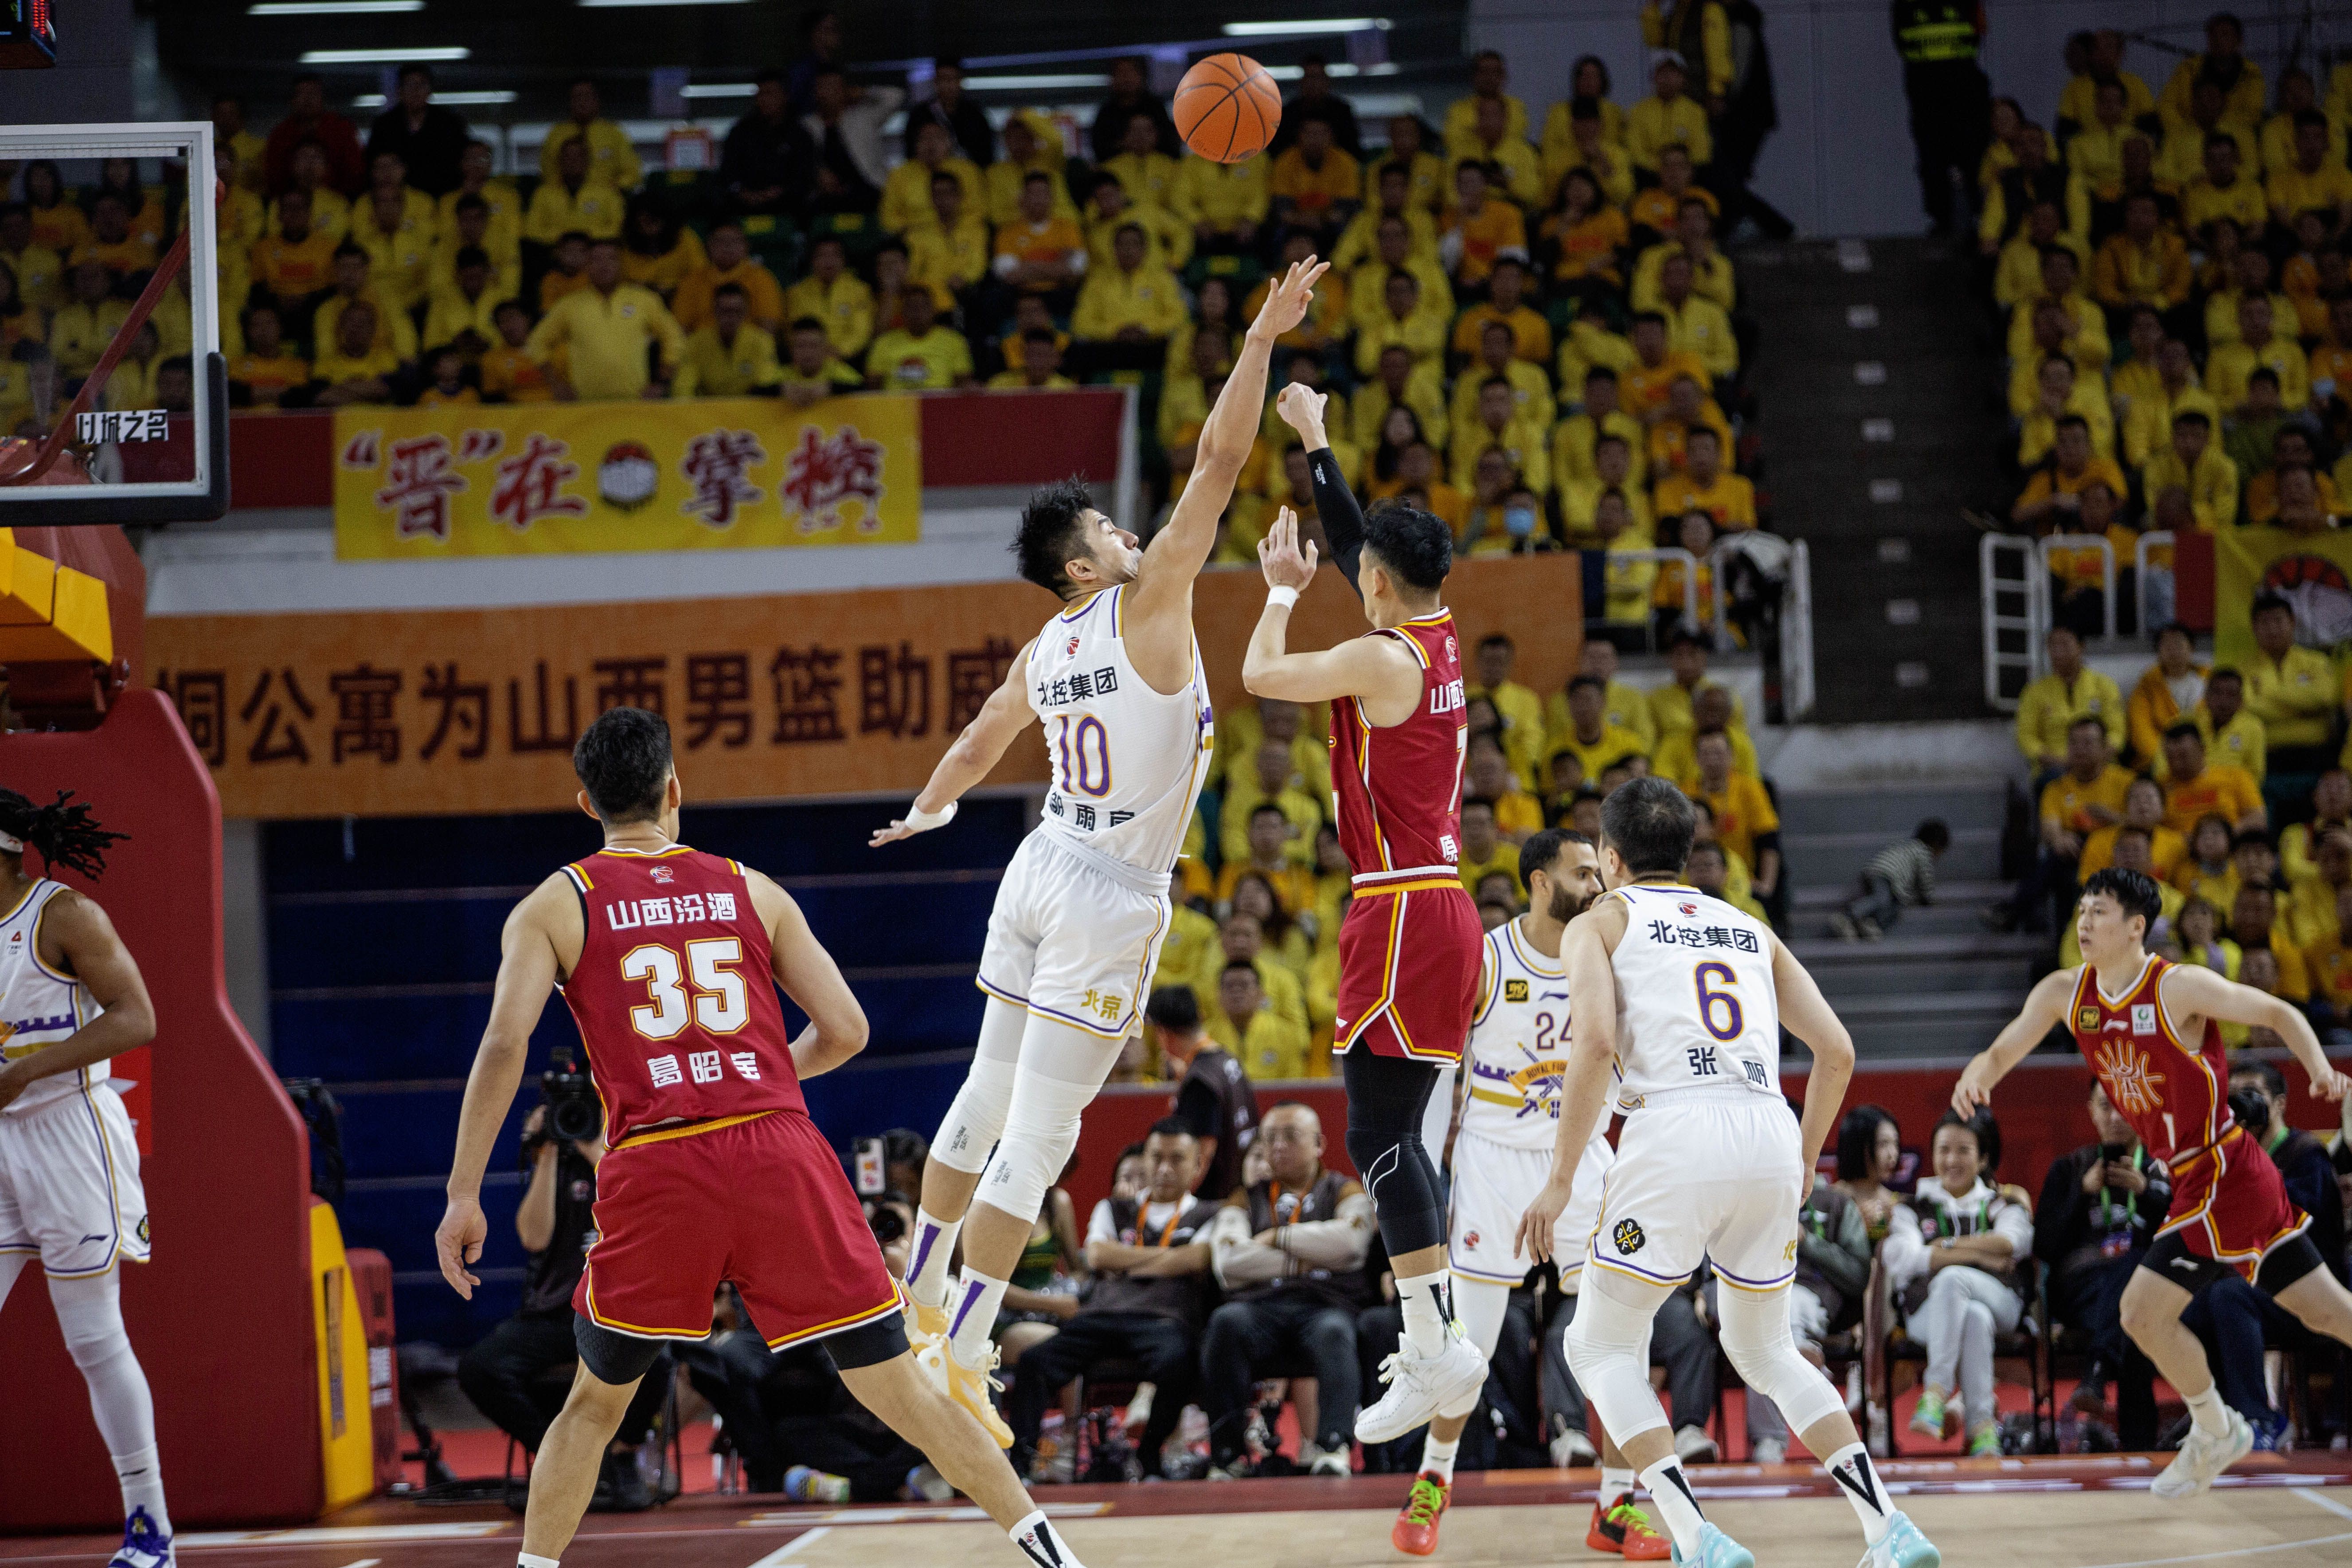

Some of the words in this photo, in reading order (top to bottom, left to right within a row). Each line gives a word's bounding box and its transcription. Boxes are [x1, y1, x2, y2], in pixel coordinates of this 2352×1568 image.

[1037, 666, 1118, 707] 北控集团
[1056, 713, 1112, 798] 10
[606, 892, 737, 931] 山西汾酒
[1647, 919, 1759, 953] 北控集团
[620, 936, 750, 1041] 35
[1080, 989, 1122, 1020] 北京
[1693, 960, 1745, 1043] 6
[647, 1050, 761, 1088] 葛昭宝
[2162, 1112, 2176, 1150] 1
